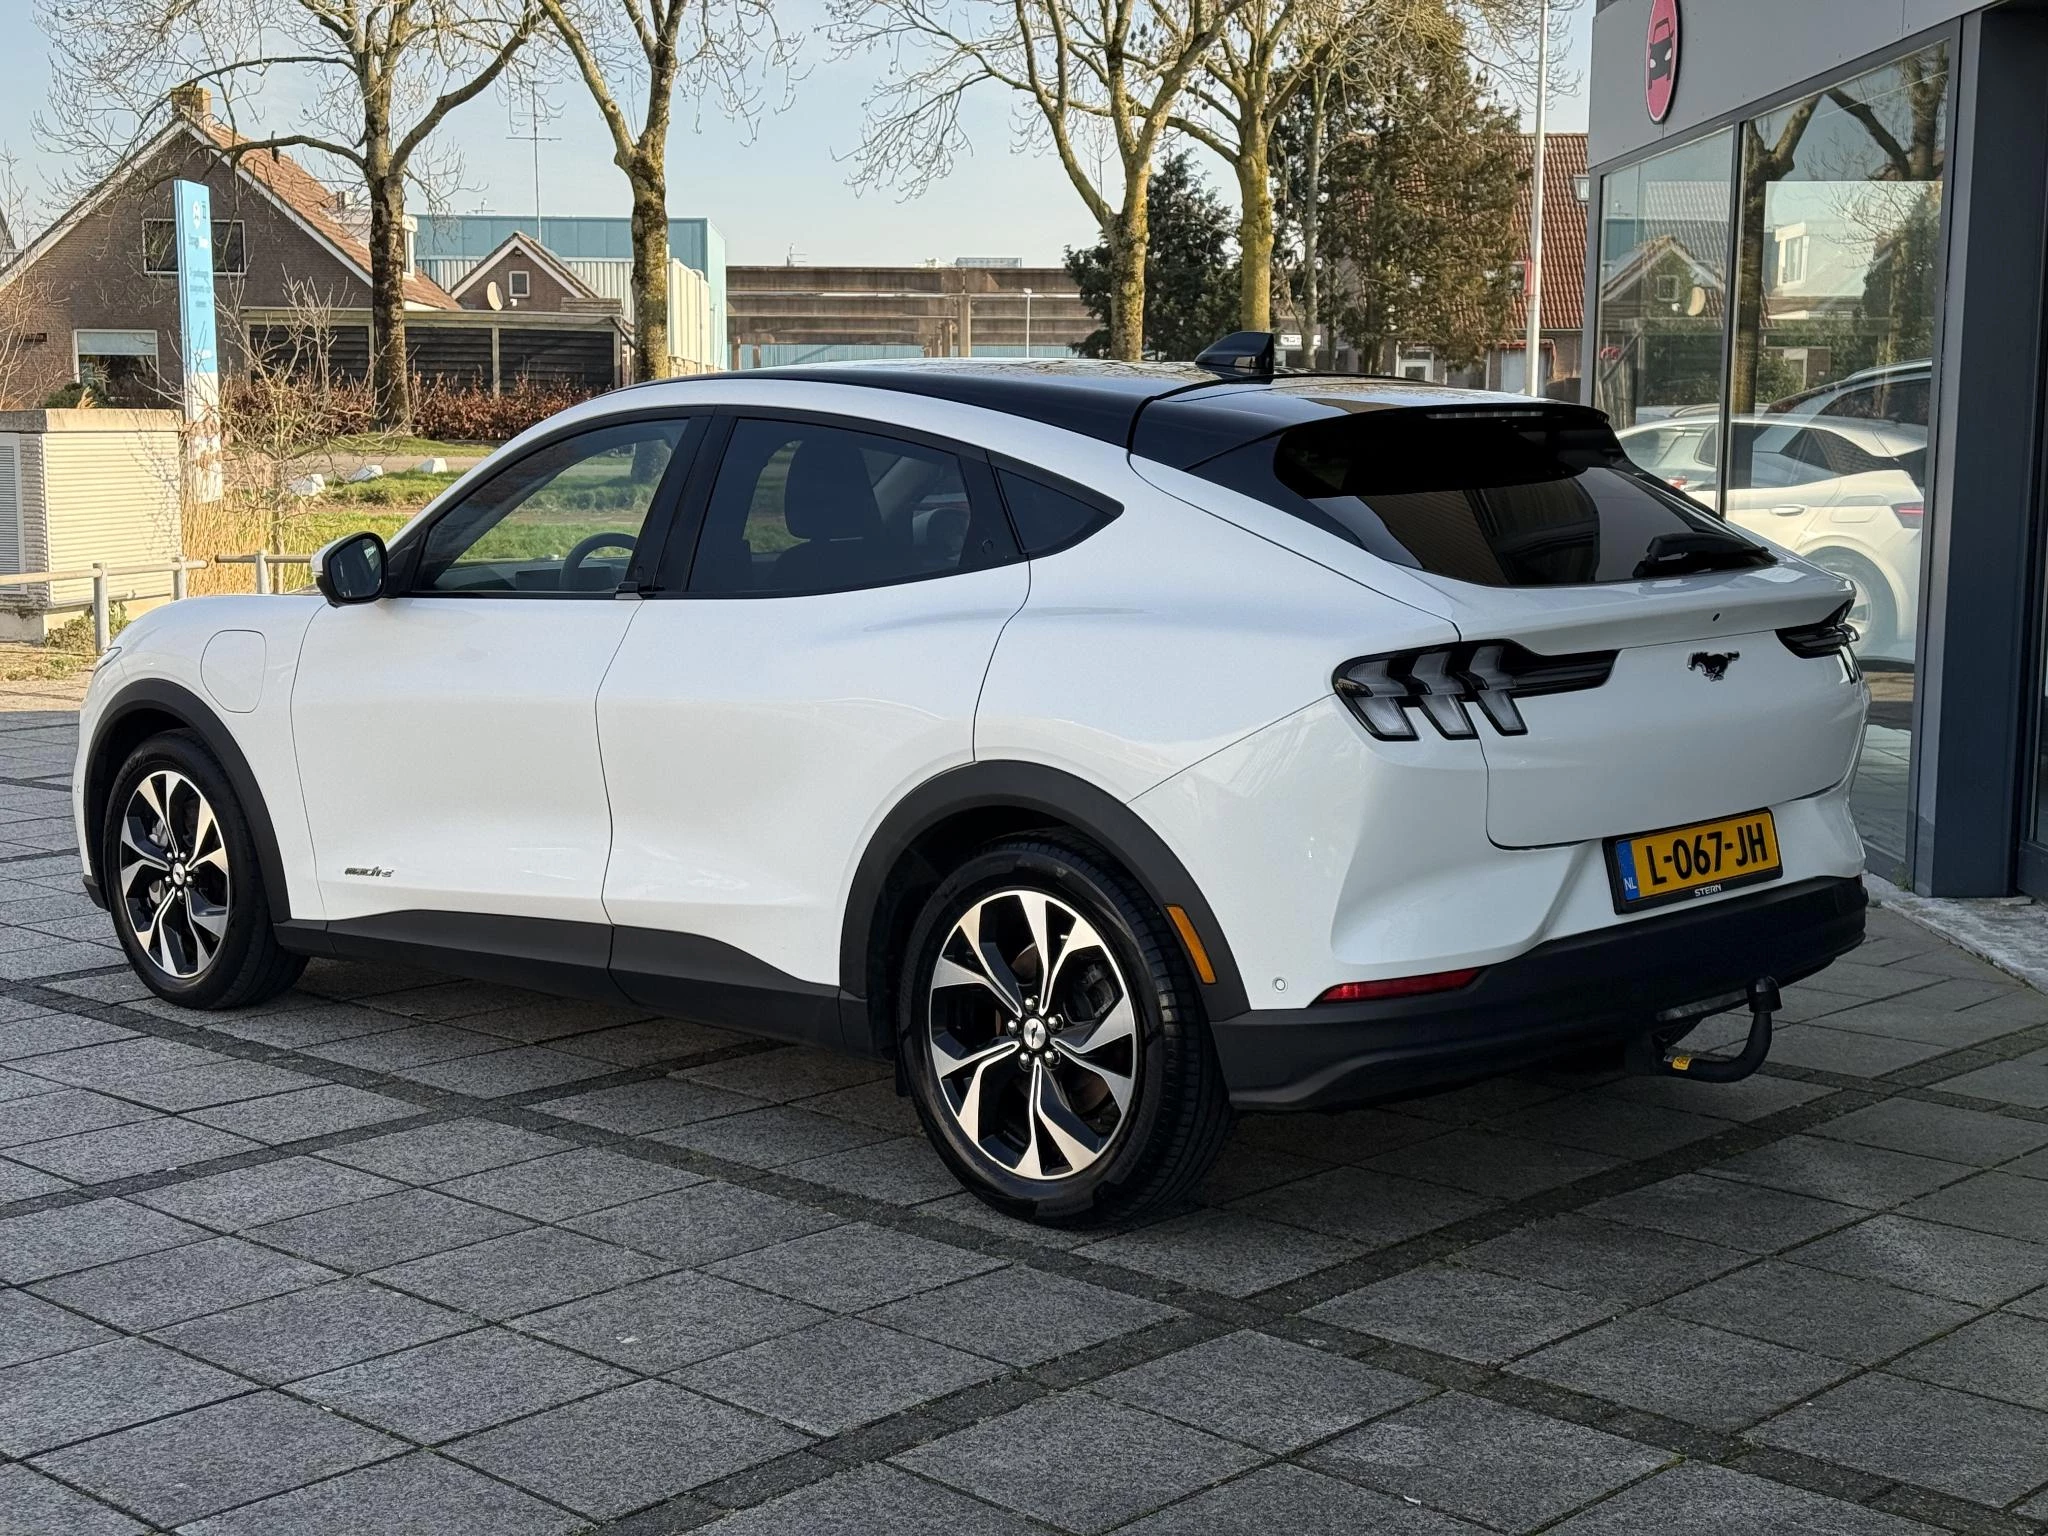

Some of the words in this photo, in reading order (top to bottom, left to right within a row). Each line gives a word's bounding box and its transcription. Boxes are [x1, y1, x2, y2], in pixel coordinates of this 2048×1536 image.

[1646, 822, 1768, 886] L-067-JH
[1624, 877, 1637, 891] NL
[1694, 883, 1722, 897] STERN
